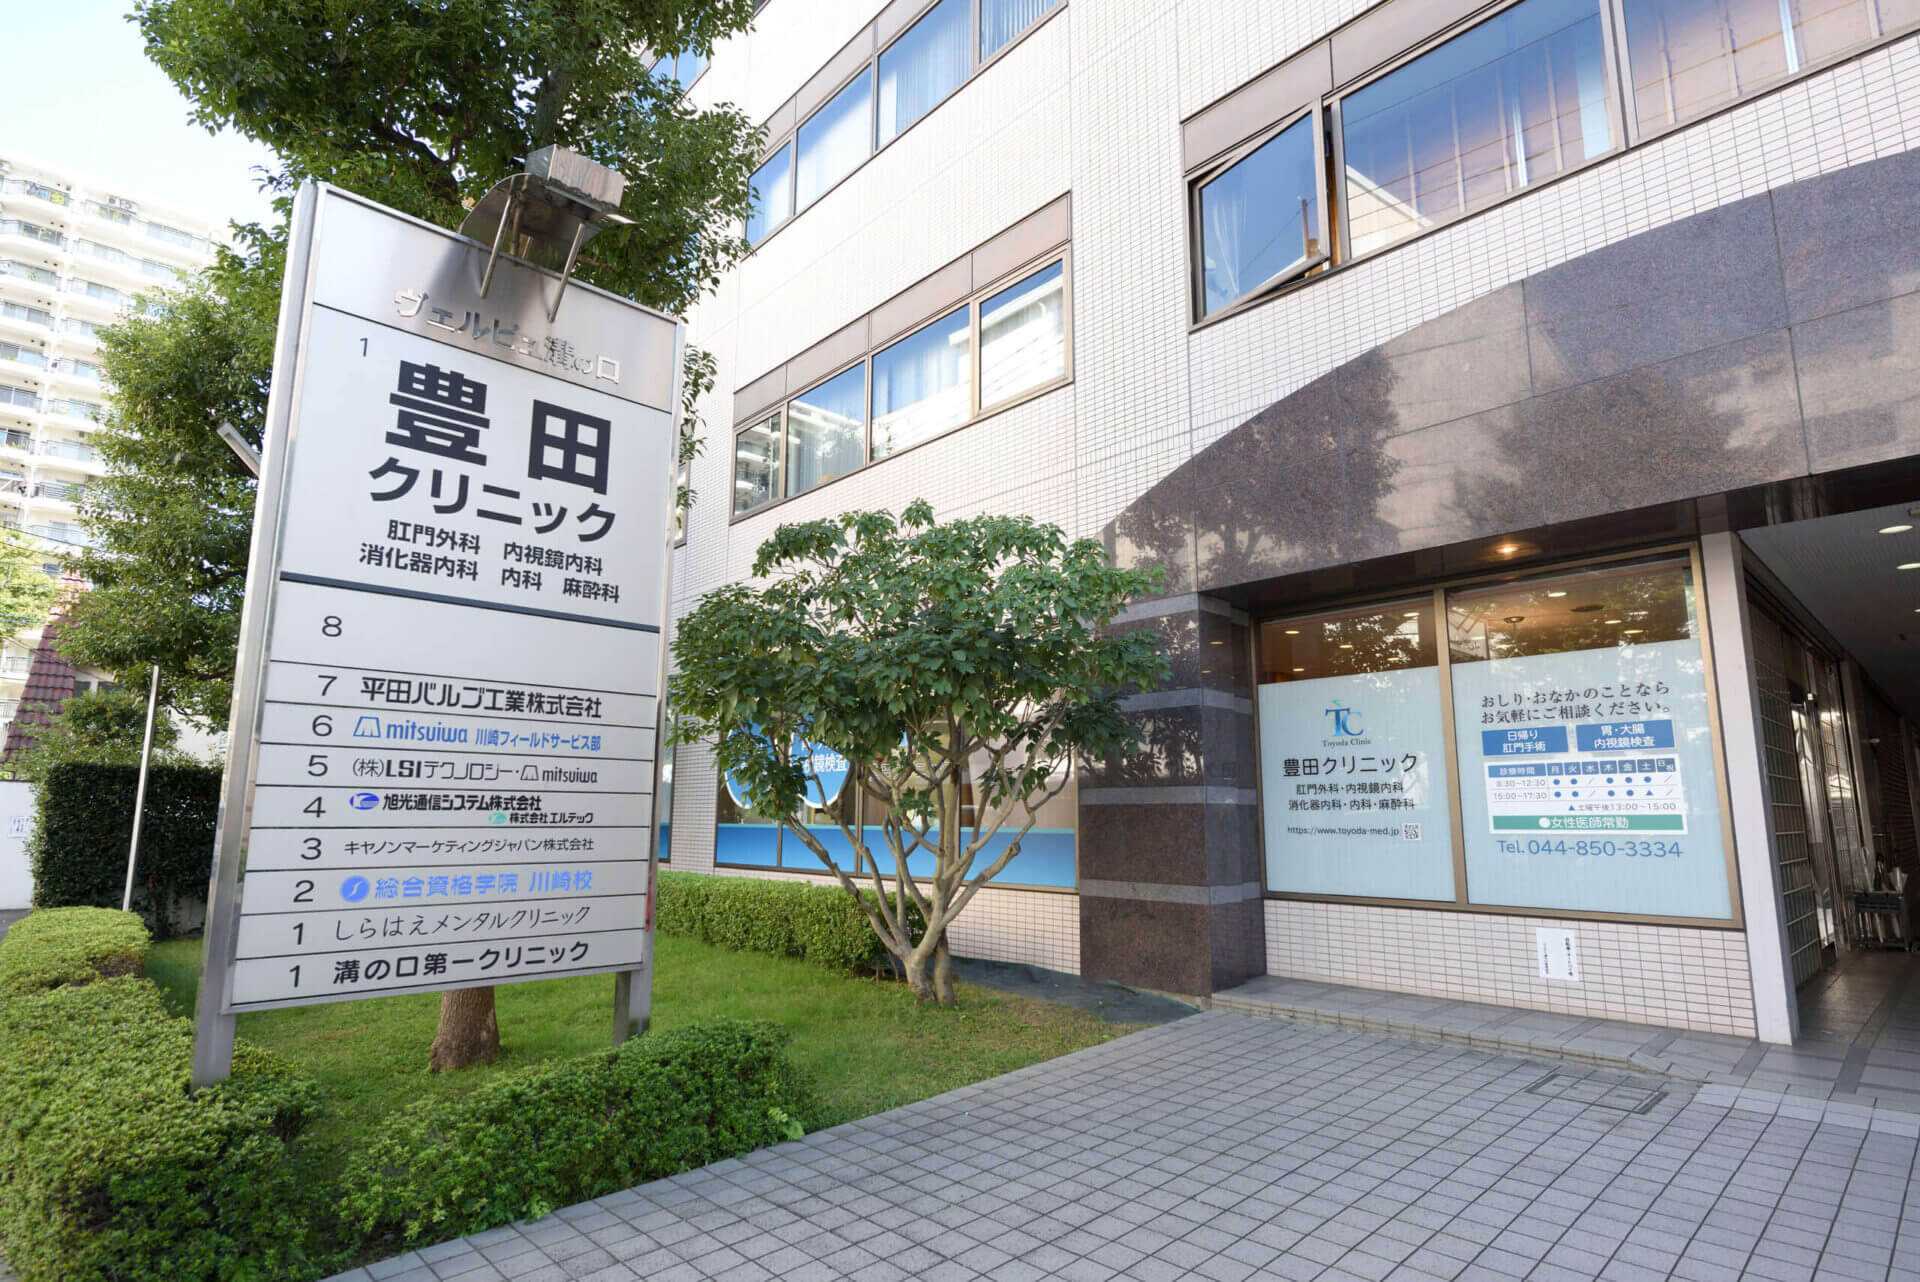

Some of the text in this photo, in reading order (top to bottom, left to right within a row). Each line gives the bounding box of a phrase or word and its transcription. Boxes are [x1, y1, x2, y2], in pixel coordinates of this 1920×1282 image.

[359, 337, 370, 357] 1
[385, 360, 612, 496] 豊田
[368, 456, 616, 544] クリニック
[387, 519, 603, 576] 肛門外科 内視鏡内科
[359, 542, 620, 603] 消化器内科 内科 麻酔科
[322, 615, 343, 638] 8
[317, 675, 338, 697] 7
[360, 676, 602, 719] 平田バルブ工業株式会社
[1481, 680, 1669, 710] おしり・おなかのことなら
[1480, 701, 1671, 724] お気軽にご相談ください。
[312, 715, 333, 737] 6
[386, 719, 601, 753] mitsuiwa 川崎フィールドサービス部
[1507, 729, 1538, 741] 日帰り
[1601, 723, 1645, 736] 胃・大腸
[1502, 741, 1546, 753] 肛門手術
[1594, 736, 1655, 748] 内視鏡検査
[307, 755, 329, 777] 5
[541, 764, 598, 784] mitsuiwa
[1283, 753, 1417, 777] 豊田クリニック
[1296, 781, 1404, 795] 肛門外科・内視鏡内科
[303, 796, 326, 818] 4
[382, 793, 543, 812] 旭光通信システム株式会社
[1288, 798, 1415, 811] 消化器内科・内科・麻酔科
[509, 812, 594, 824] 株式会社エルテック
[301, 837, 323, 861] 3
[1527, 839, 1683, 858] 044-850-3334
[292, 879, 315, 903] 2
[374, 870, 594, 900] 総合資格学院 川崎校
[292, 921, 305, 946] 1
[335, 905, 591, 942] しらはえメンタルクリニック
[333, 940, 590, 985] 溝の口第一クリニック
[288, 964, 302, 988] 1
